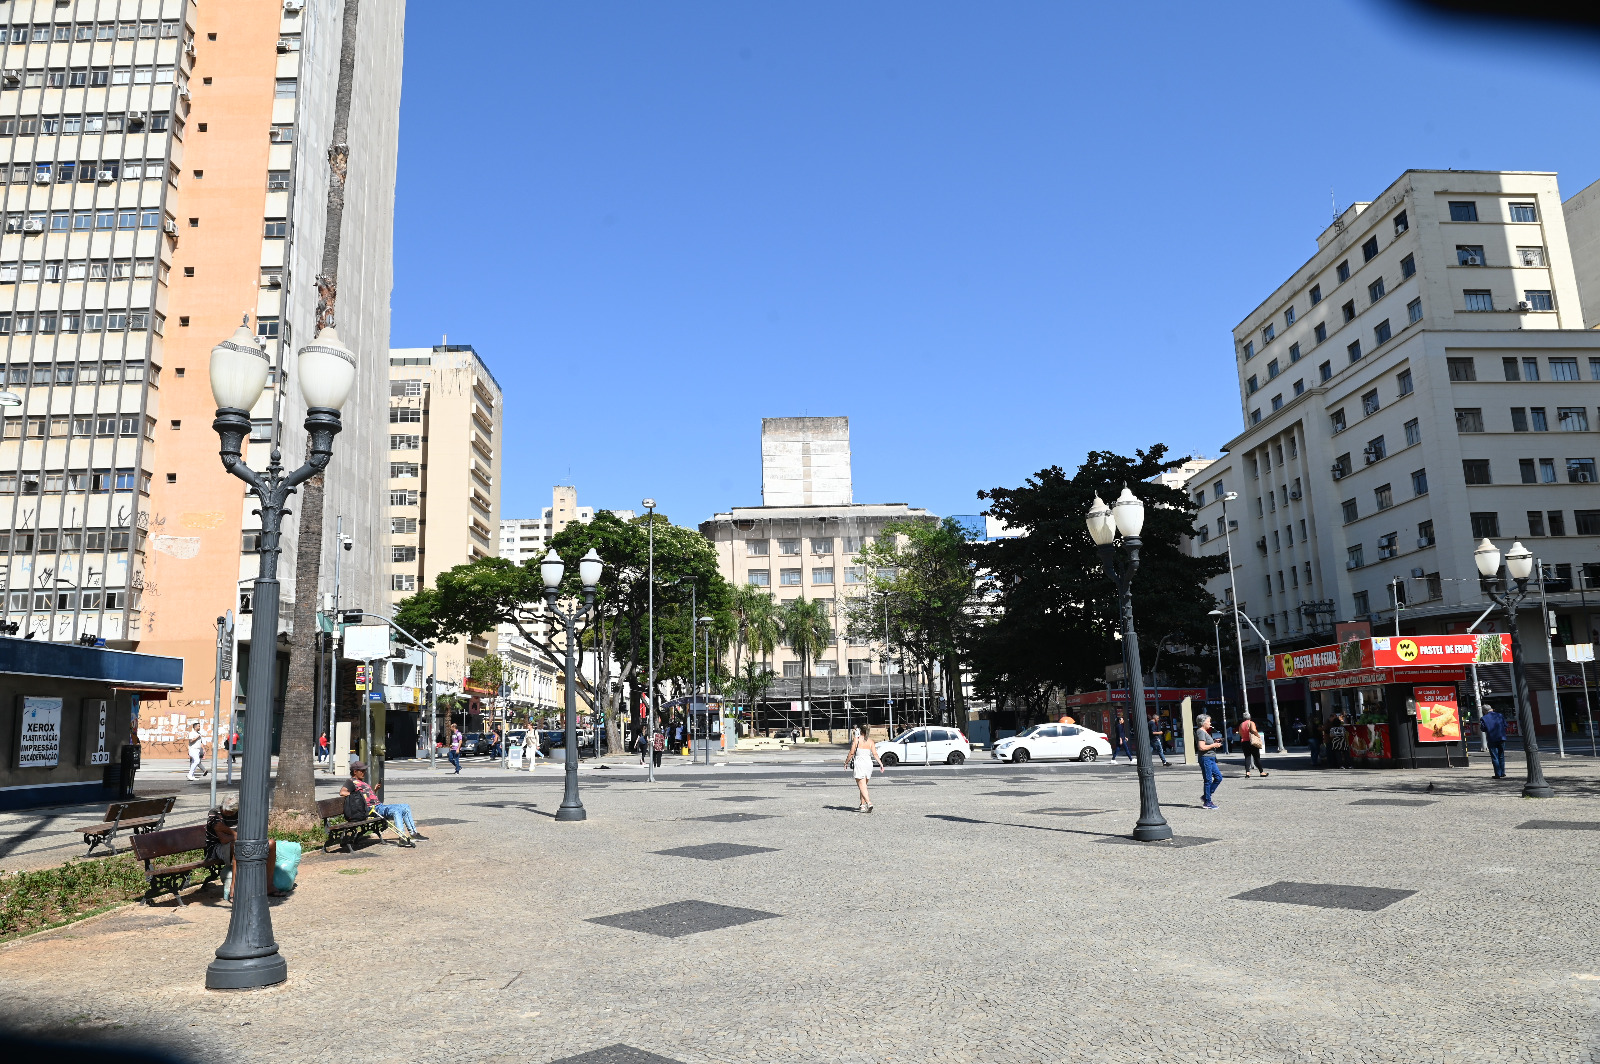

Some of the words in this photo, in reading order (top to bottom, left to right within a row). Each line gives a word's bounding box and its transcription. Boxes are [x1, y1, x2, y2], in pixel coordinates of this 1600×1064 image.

[1419, 645, 1444, 655] PASTEL
[1445, 645, 1455, 654] DE
[1454, 644, 1474, 654] FEIRA
[1293, 654, 1313, 670] PASTEL
[1312, 653, 1321, 667] DE
[1320, 650, 1338, 665] FEIRA
[27, 723, 55, 732] XEROX
[20, 743, 58, 752] IMPRESSÃO
